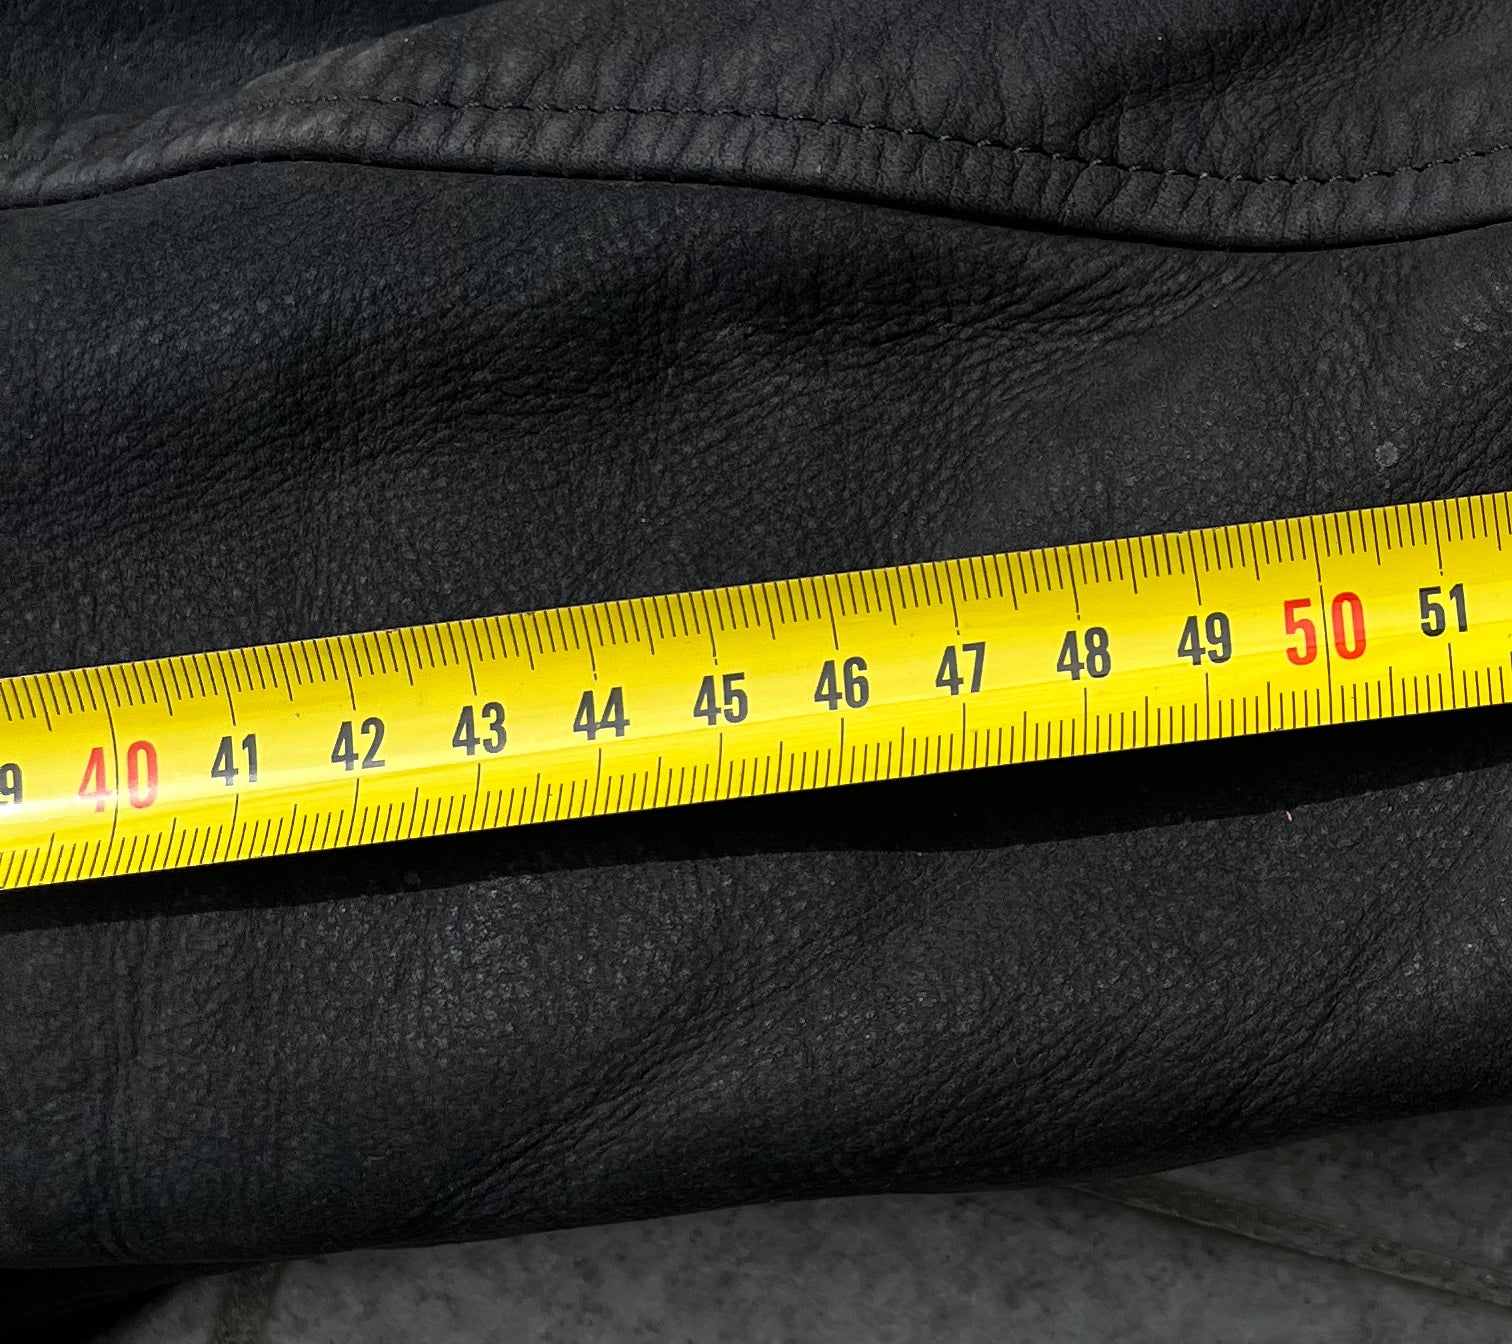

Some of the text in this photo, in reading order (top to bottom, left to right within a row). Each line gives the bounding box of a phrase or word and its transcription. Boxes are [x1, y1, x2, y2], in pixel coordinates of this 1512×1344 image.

[0, 762, 22, 805] 9
[78, 740, 159, 812] 40
[210, 733, 258, 786] 41
[331, 717, 385, 771] 42
[453, 702, 506, 755] 43
[574, 687, 629, 740] 44
[694, 673, 747, 725] 45
[815, 657, 868, 710] 46
[936, 642, 985, 695] 47
[1057, 627, 1110, 680] 48
[1178, 612, 1231, 665] 49
[1283, 592, 1366, 665] 50
[1419, 584, 1467, 636] 51
